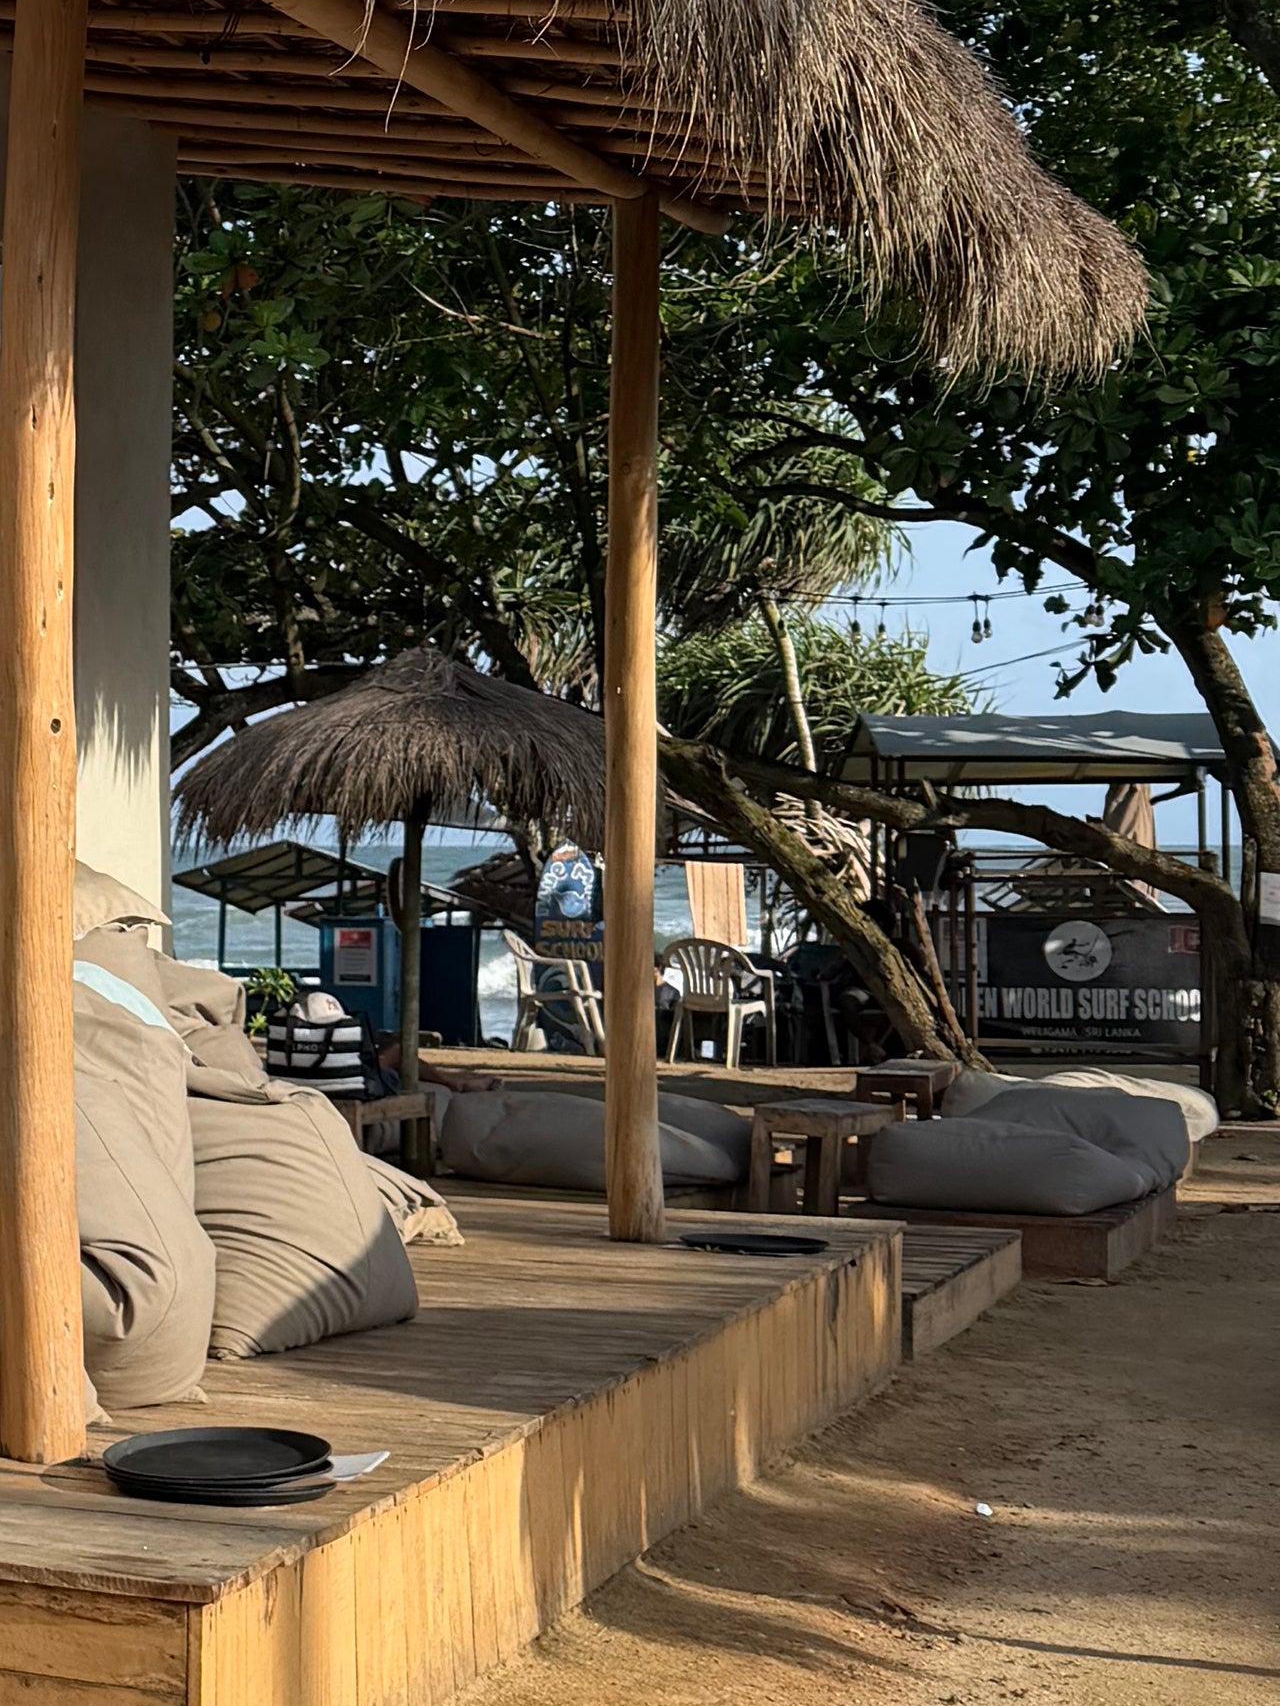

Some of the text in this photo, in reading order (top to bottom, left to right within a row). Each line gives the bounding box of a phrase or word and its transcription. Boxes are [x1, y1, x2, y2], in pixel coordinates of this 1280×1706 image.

[1002, 987, 1074, 1020] WORLD
[1078, 987, 1130, 1021] SURF
[1134, 988, 1201, 1023] SCHOO
